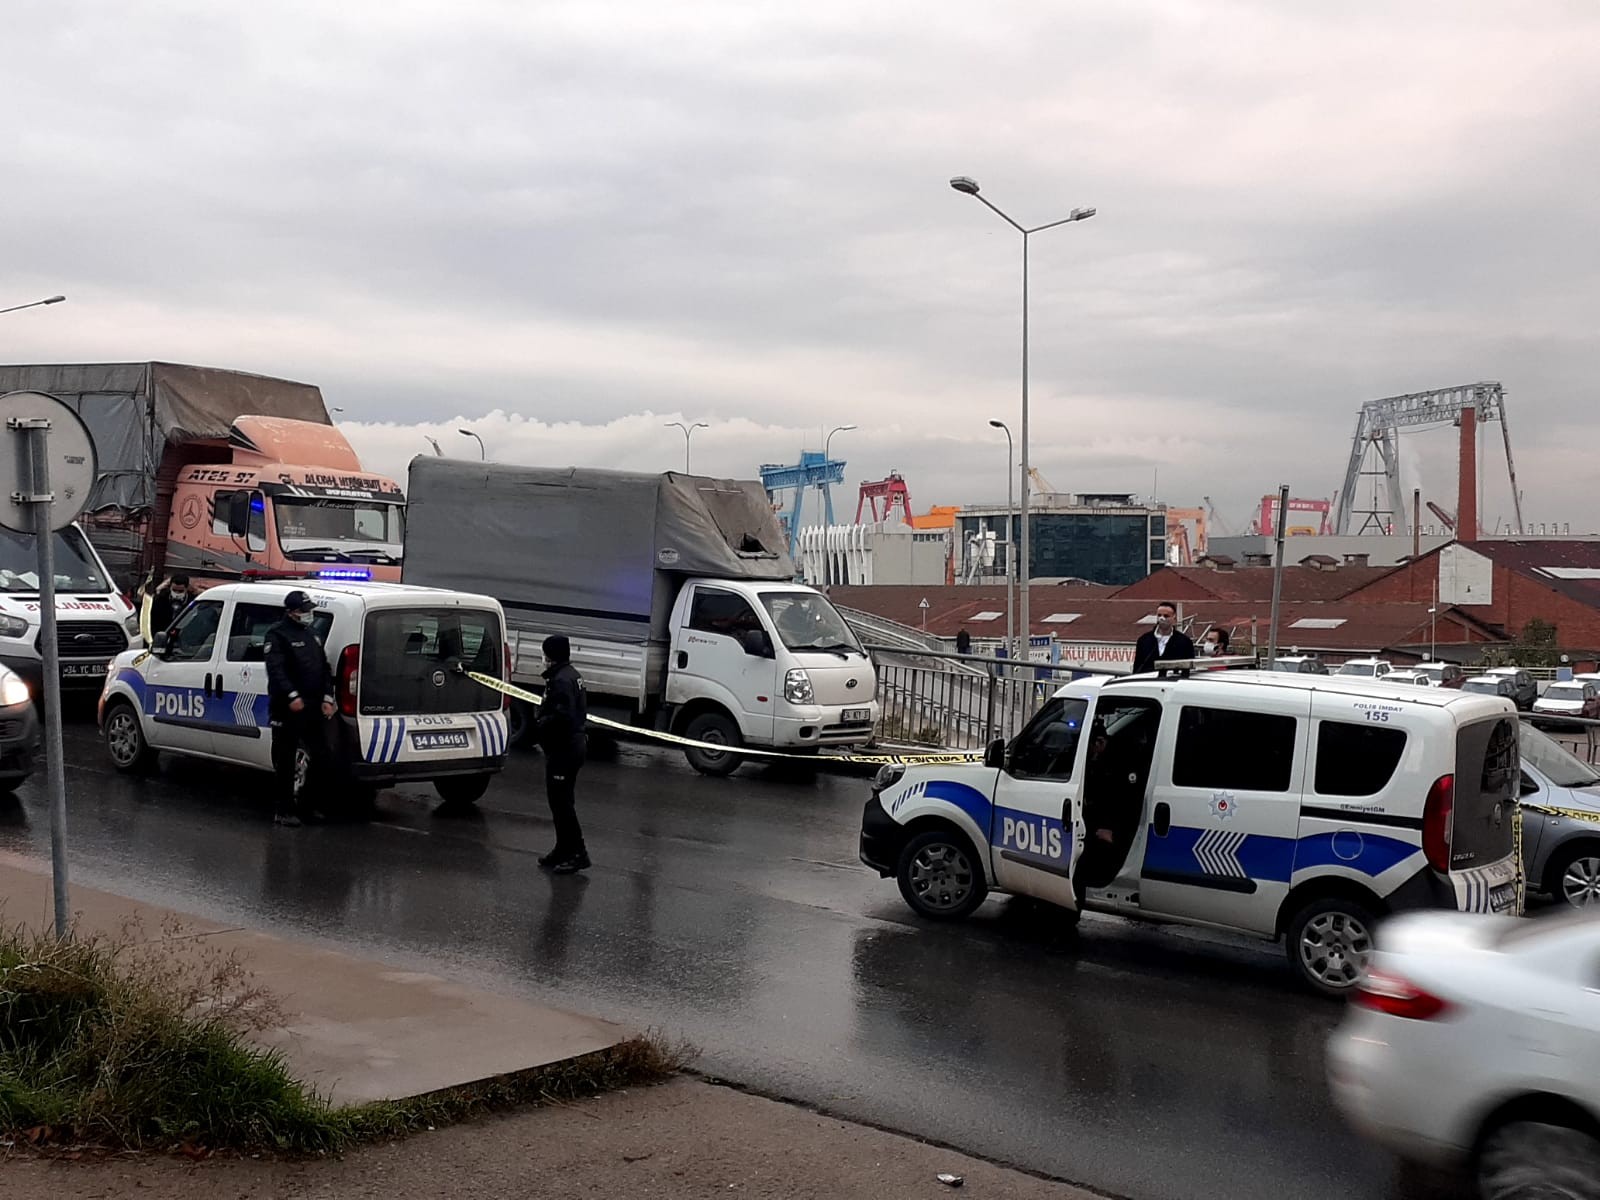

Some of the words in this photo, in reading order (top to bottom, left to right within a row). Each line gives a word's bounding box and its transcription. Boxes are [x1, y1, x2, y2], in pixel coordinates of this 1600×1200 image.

[155, 689, 205, 718] POLİS
[1364, 711, 1389, 722] 155
[1003, 816, 1062, 858] POLİS
